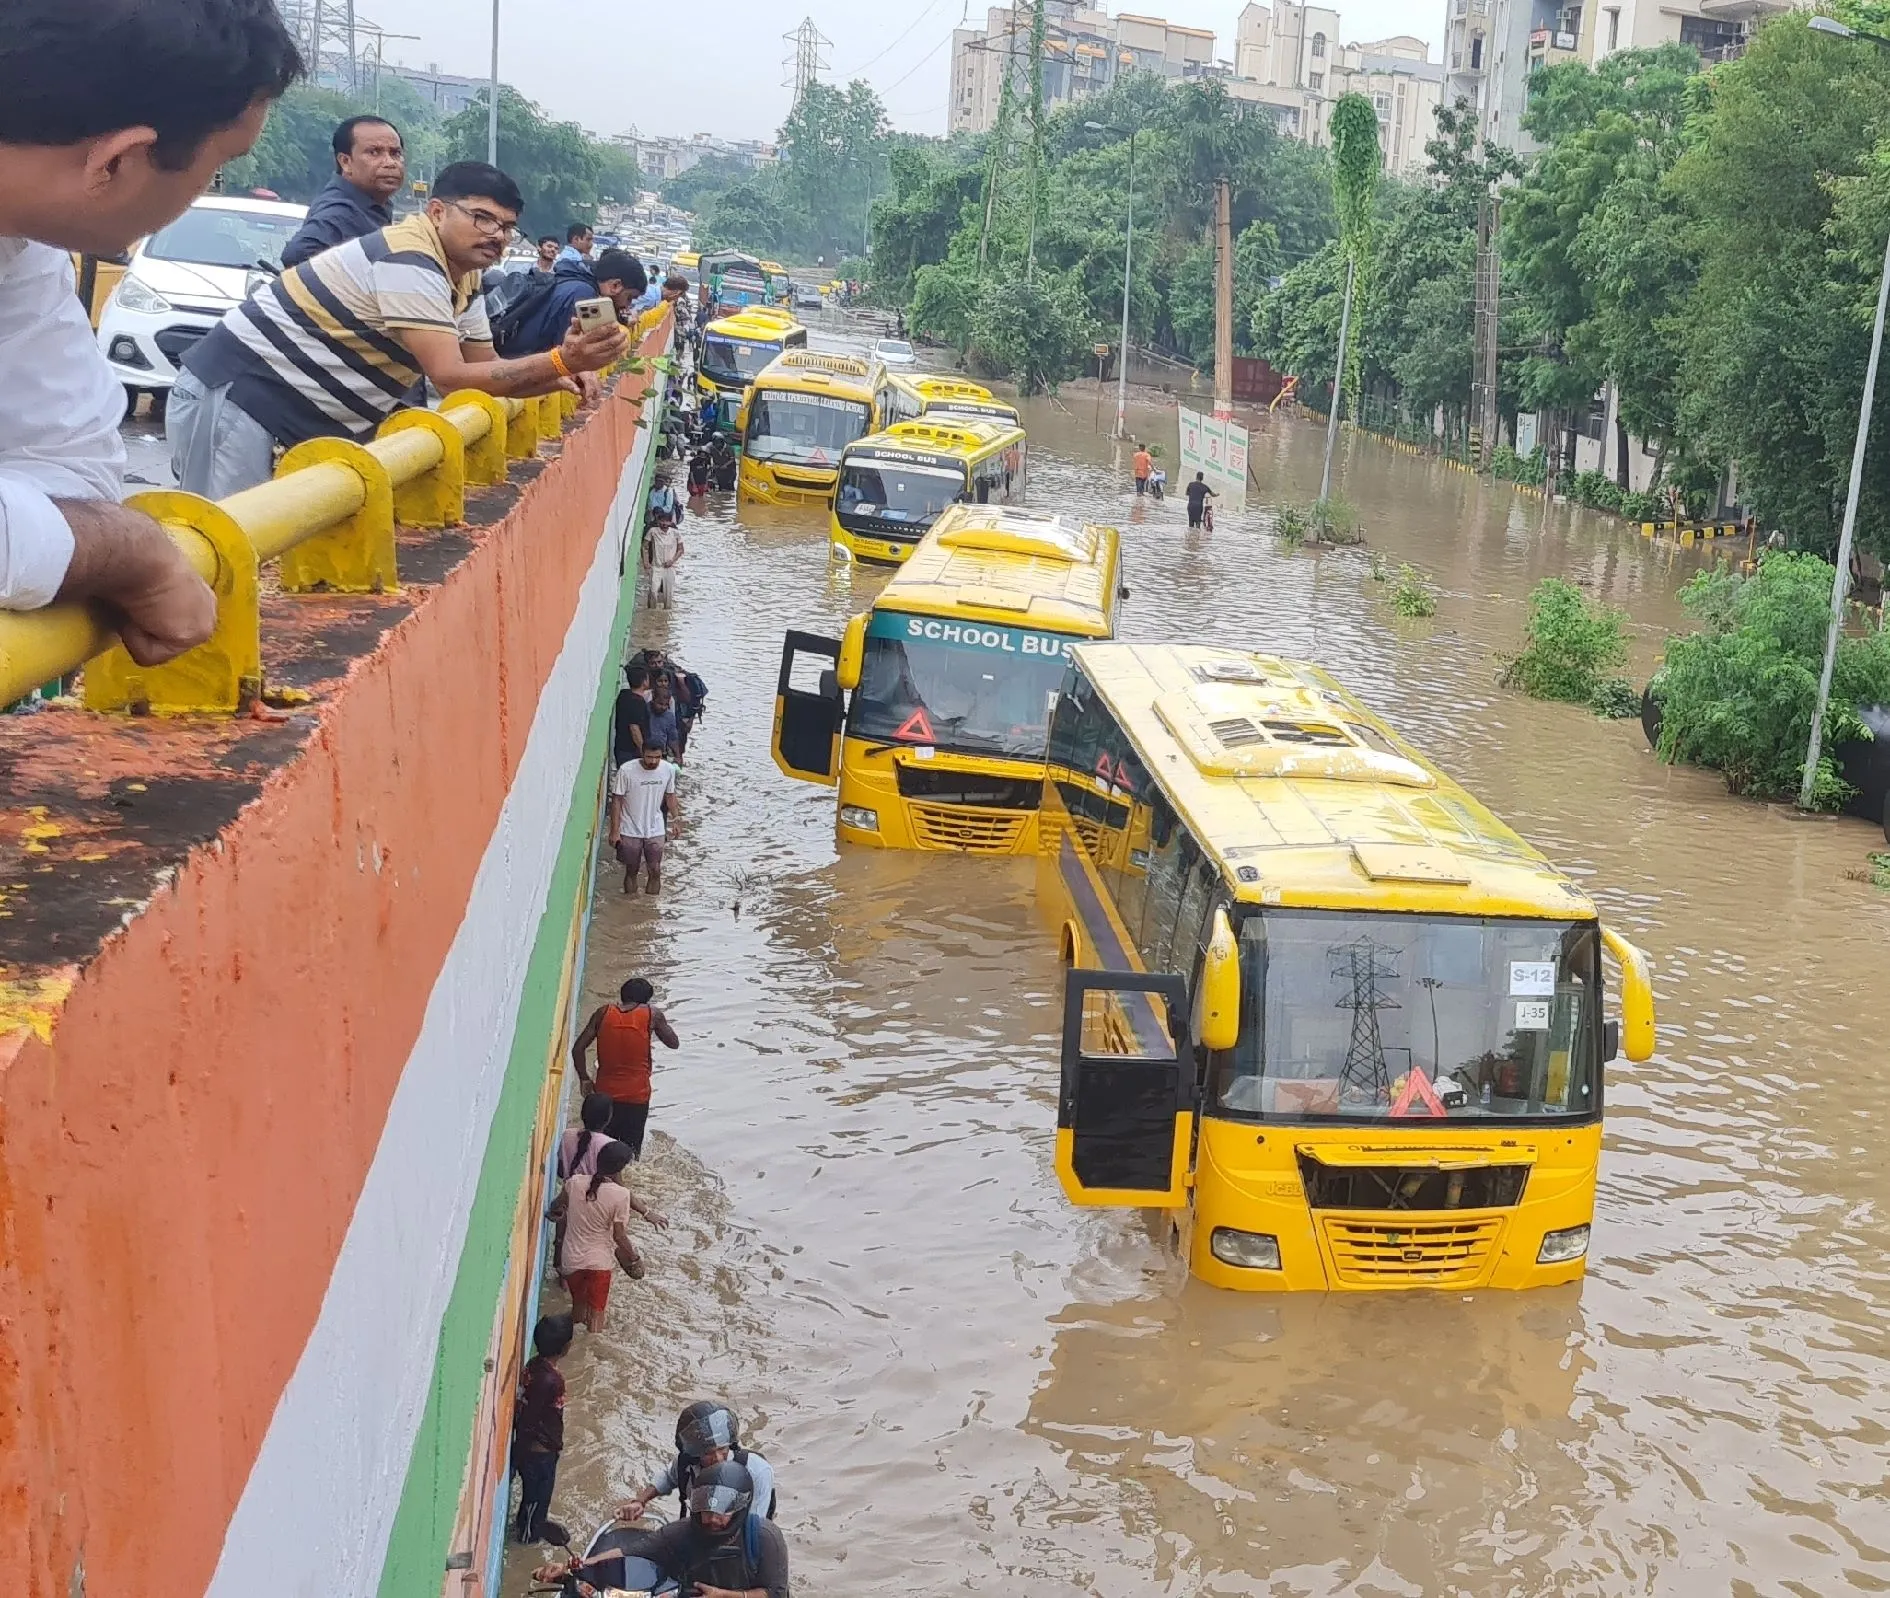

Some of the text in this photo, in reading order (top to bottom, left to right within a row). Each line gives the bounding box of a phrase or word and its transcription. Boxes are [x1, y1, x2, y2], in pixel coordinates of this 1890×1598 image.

[948, 404, 997, 415] SCHOOL BUS
[874, 450, 937, 465] SCHOOL BUS
[907, 619, 1074, 659] SCHOOL BUS
[1513, 968, 1551, 983] S-12
[1521, 1007, 1546, 1019] J-35
